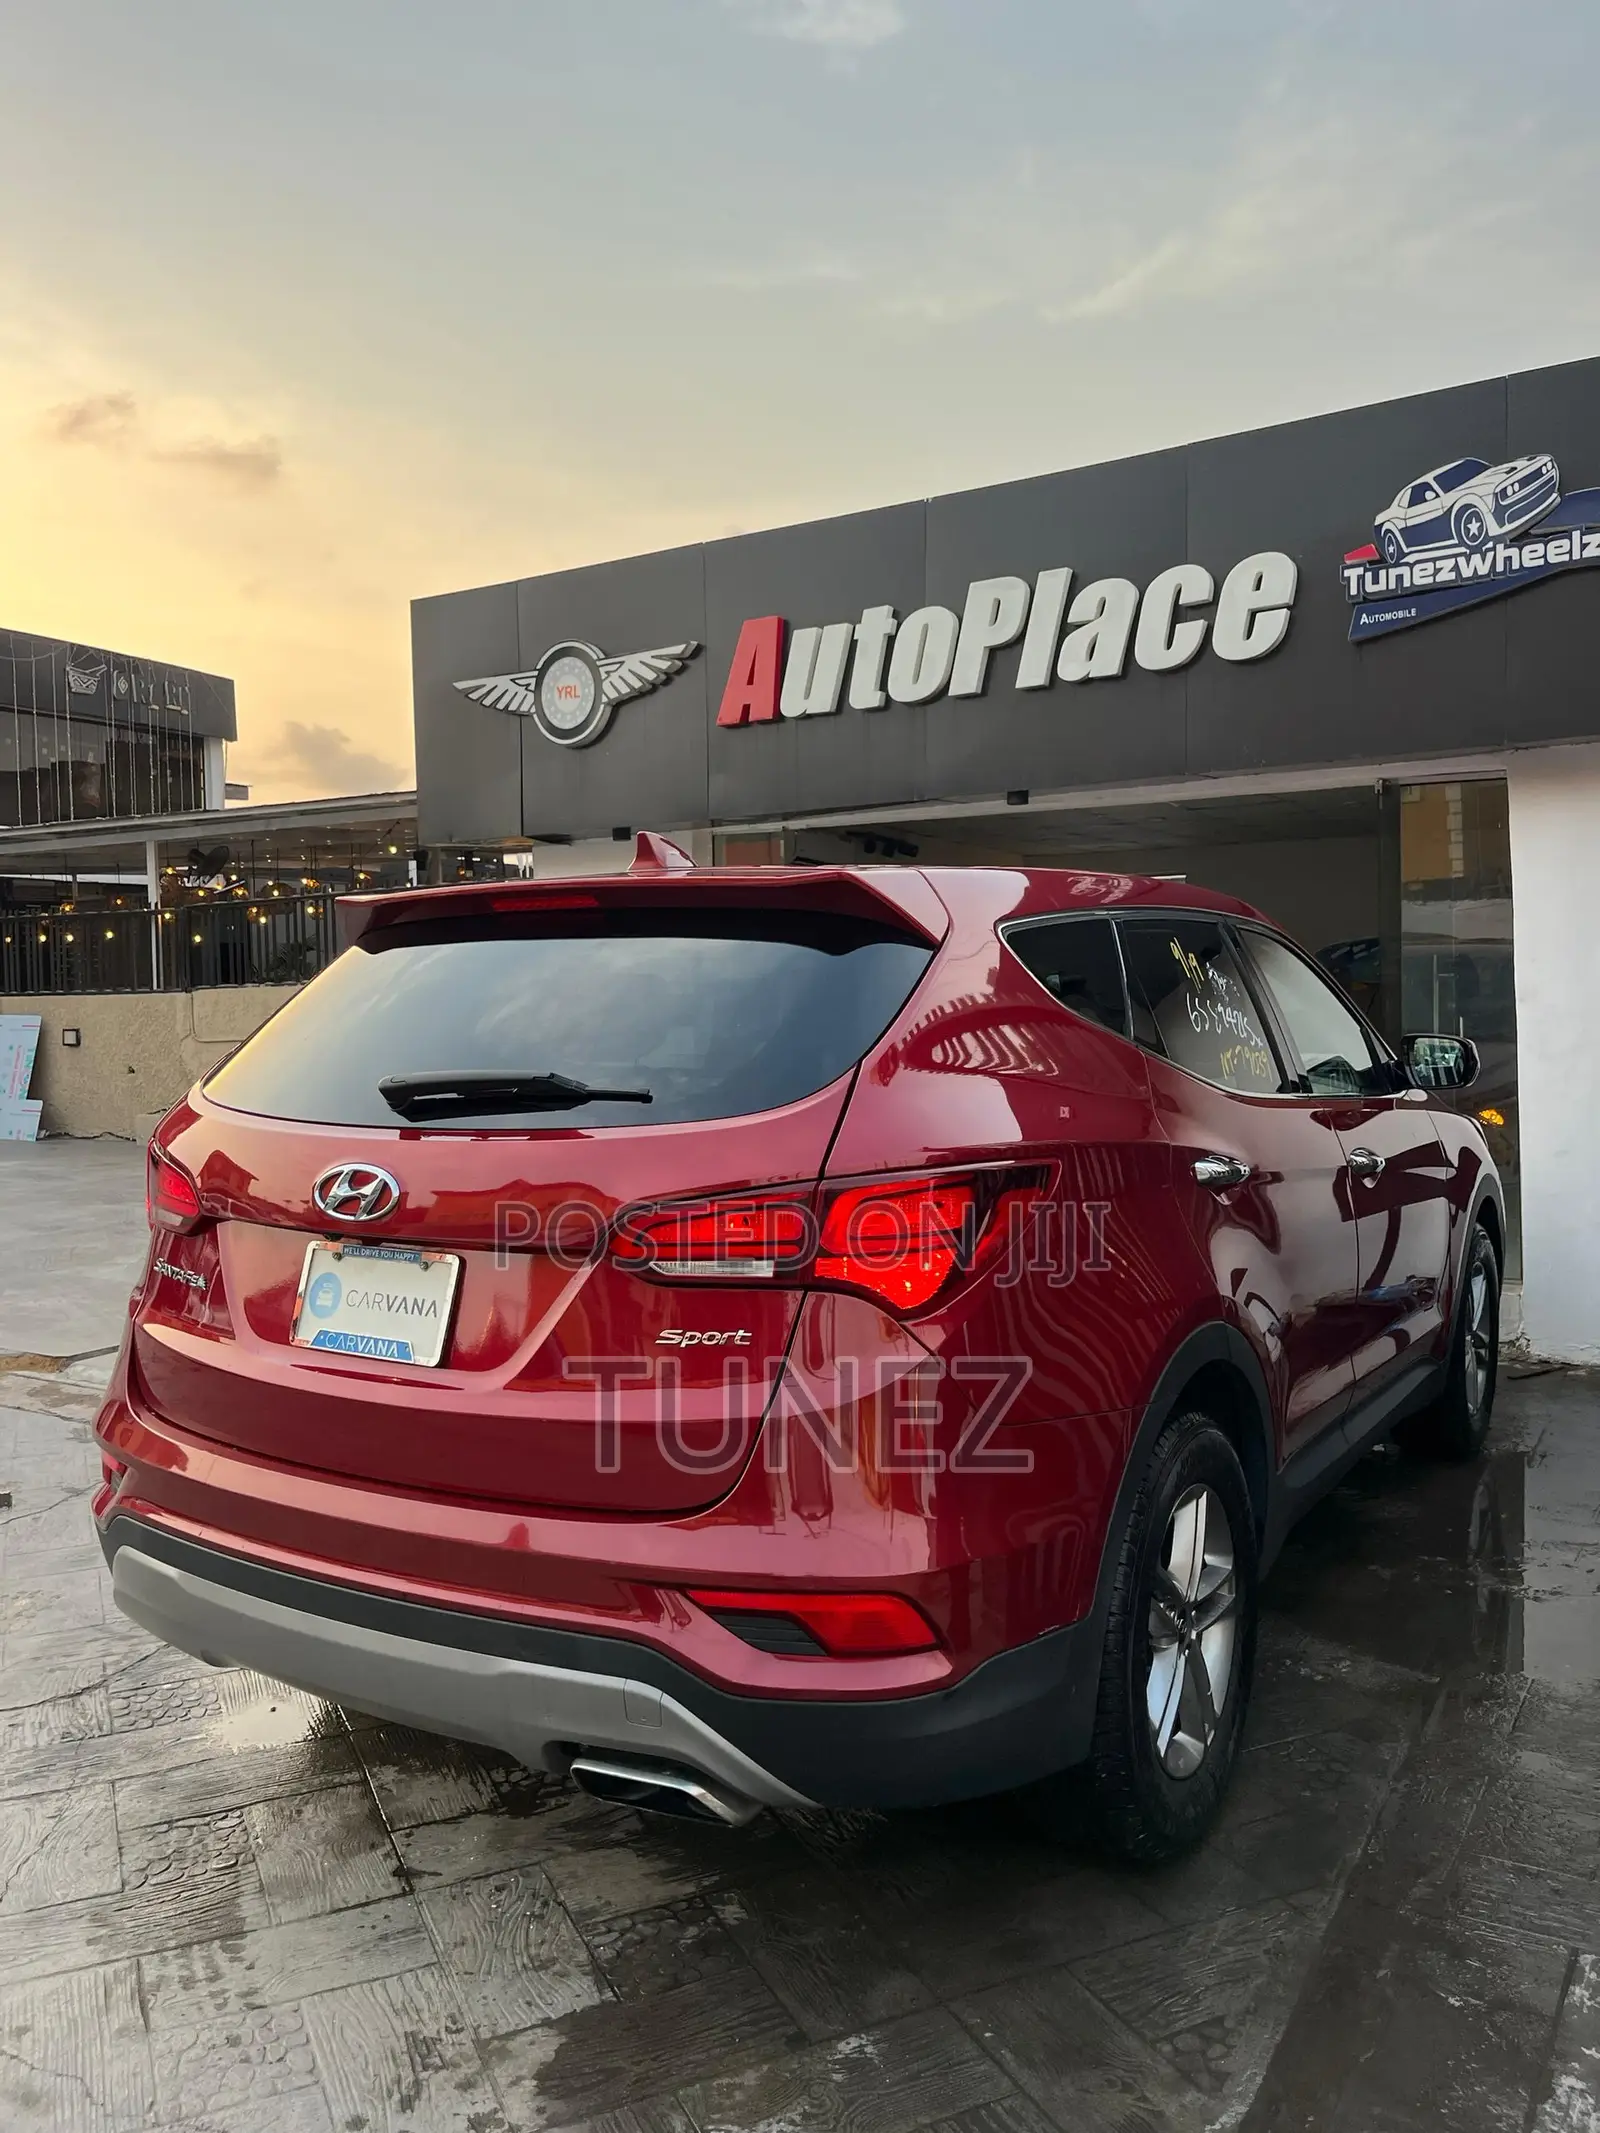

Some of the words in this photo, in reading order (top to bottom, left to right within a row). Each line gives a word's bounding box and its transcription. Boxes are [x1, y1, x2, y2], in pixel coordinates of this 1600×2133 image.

[1359, 607, 1418, 626] AUTOMOBILE
[716, 551, 1300, 728] AutoPlace
[556, 684, 581, 699] YRL
[343, 1246, 361, 1256] WE'LL
[361, 1248, 380, 1258] DRIVE
[380, 1250, 395, 1259] YOU
[394, 1252, 415, 1261] HAPPY
[346, 1289, 438, 1319] CARVANA
[325, 1332, 399, 1358] CARVANA
[655, 1329, 753, 1348] Sport
